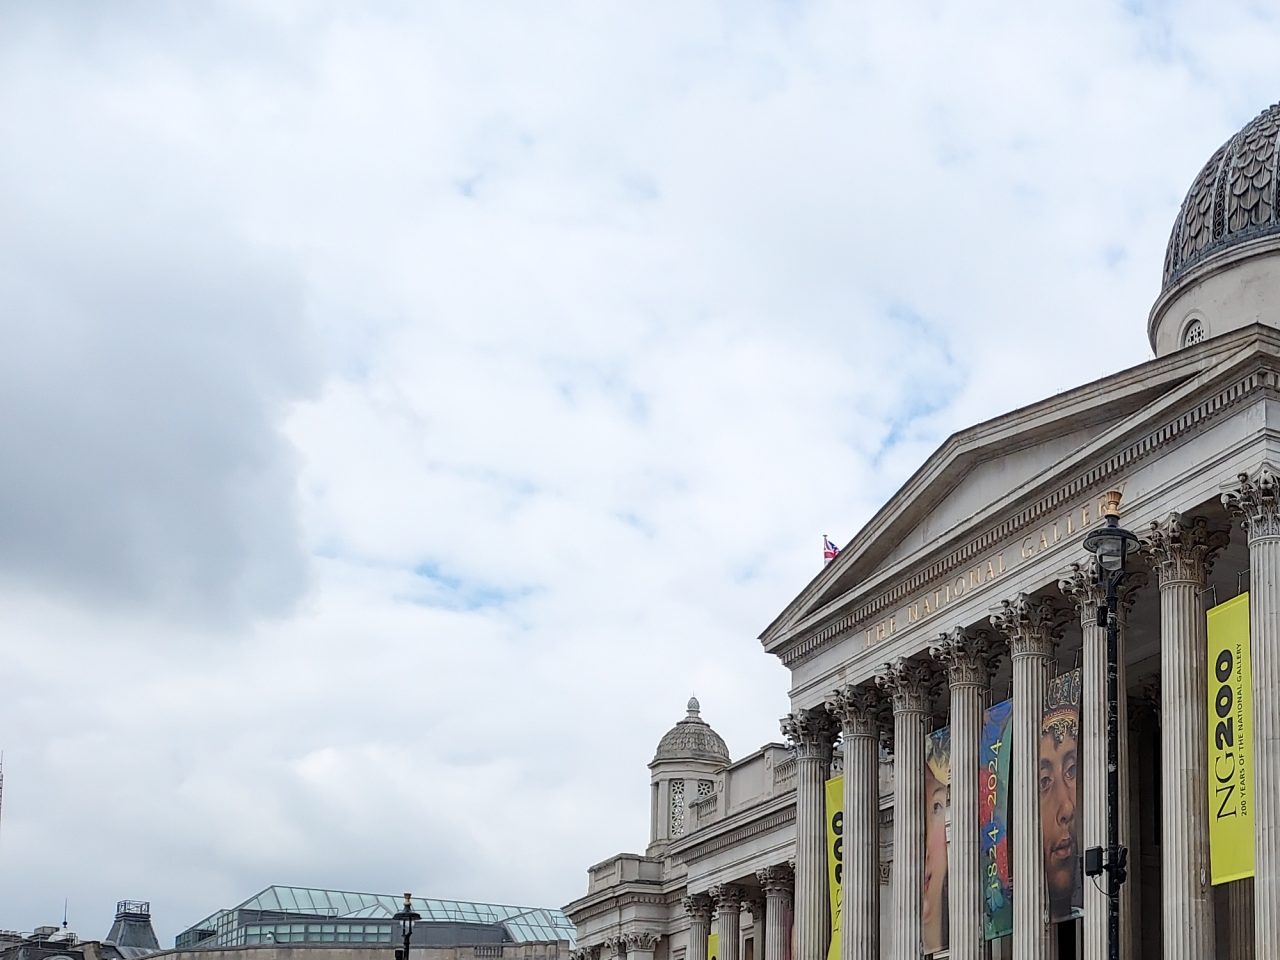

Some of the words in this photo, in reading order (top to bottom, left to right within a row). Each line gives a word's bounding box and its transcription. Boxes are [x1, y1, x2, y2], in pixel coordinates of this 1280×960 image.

[864, 616, 897, 648] THE
[907, 554, 1008, 624] NATIONAL
[1215, 649, 1237, 823] NG200
[1238, 753, 1245, 766] OF
[1239, 767, 1247, 798] YEARS
